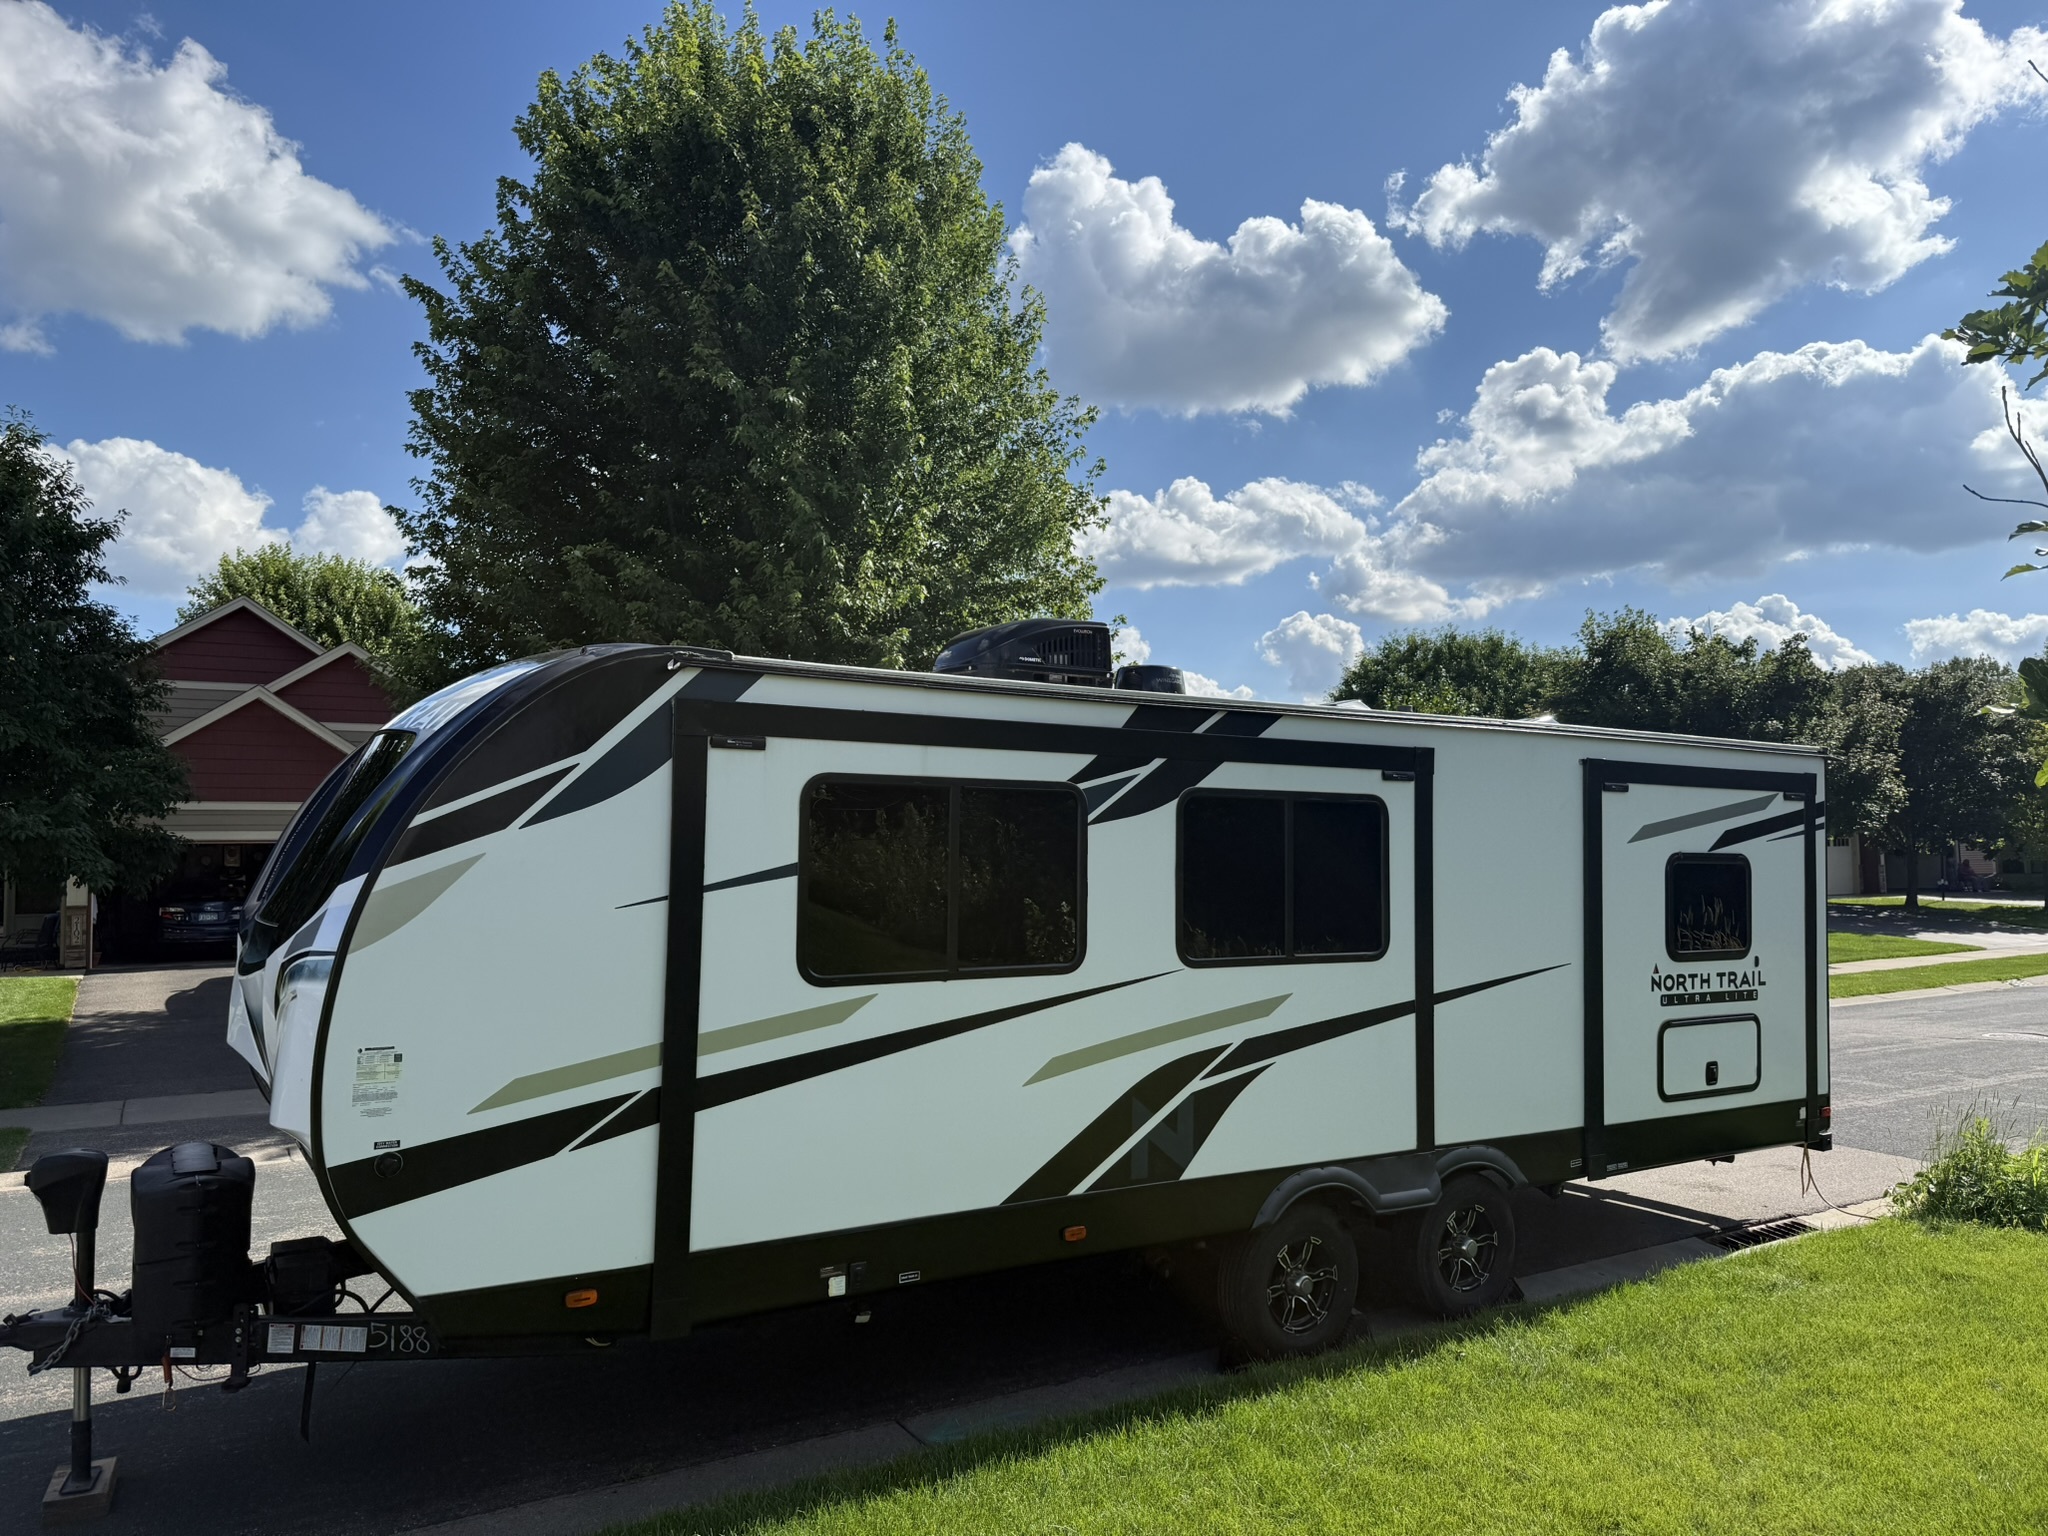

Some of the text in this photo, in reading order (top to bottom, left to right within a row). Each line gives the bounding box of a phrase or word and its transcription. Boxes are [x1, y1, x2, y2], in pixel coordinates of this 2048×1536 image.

[1651, 970, 1766, 992] NORTH TRAIL
[1662, 991, 1758, 1004] ULTRA LITE
[369, 1322, 430, 1353] 5188
